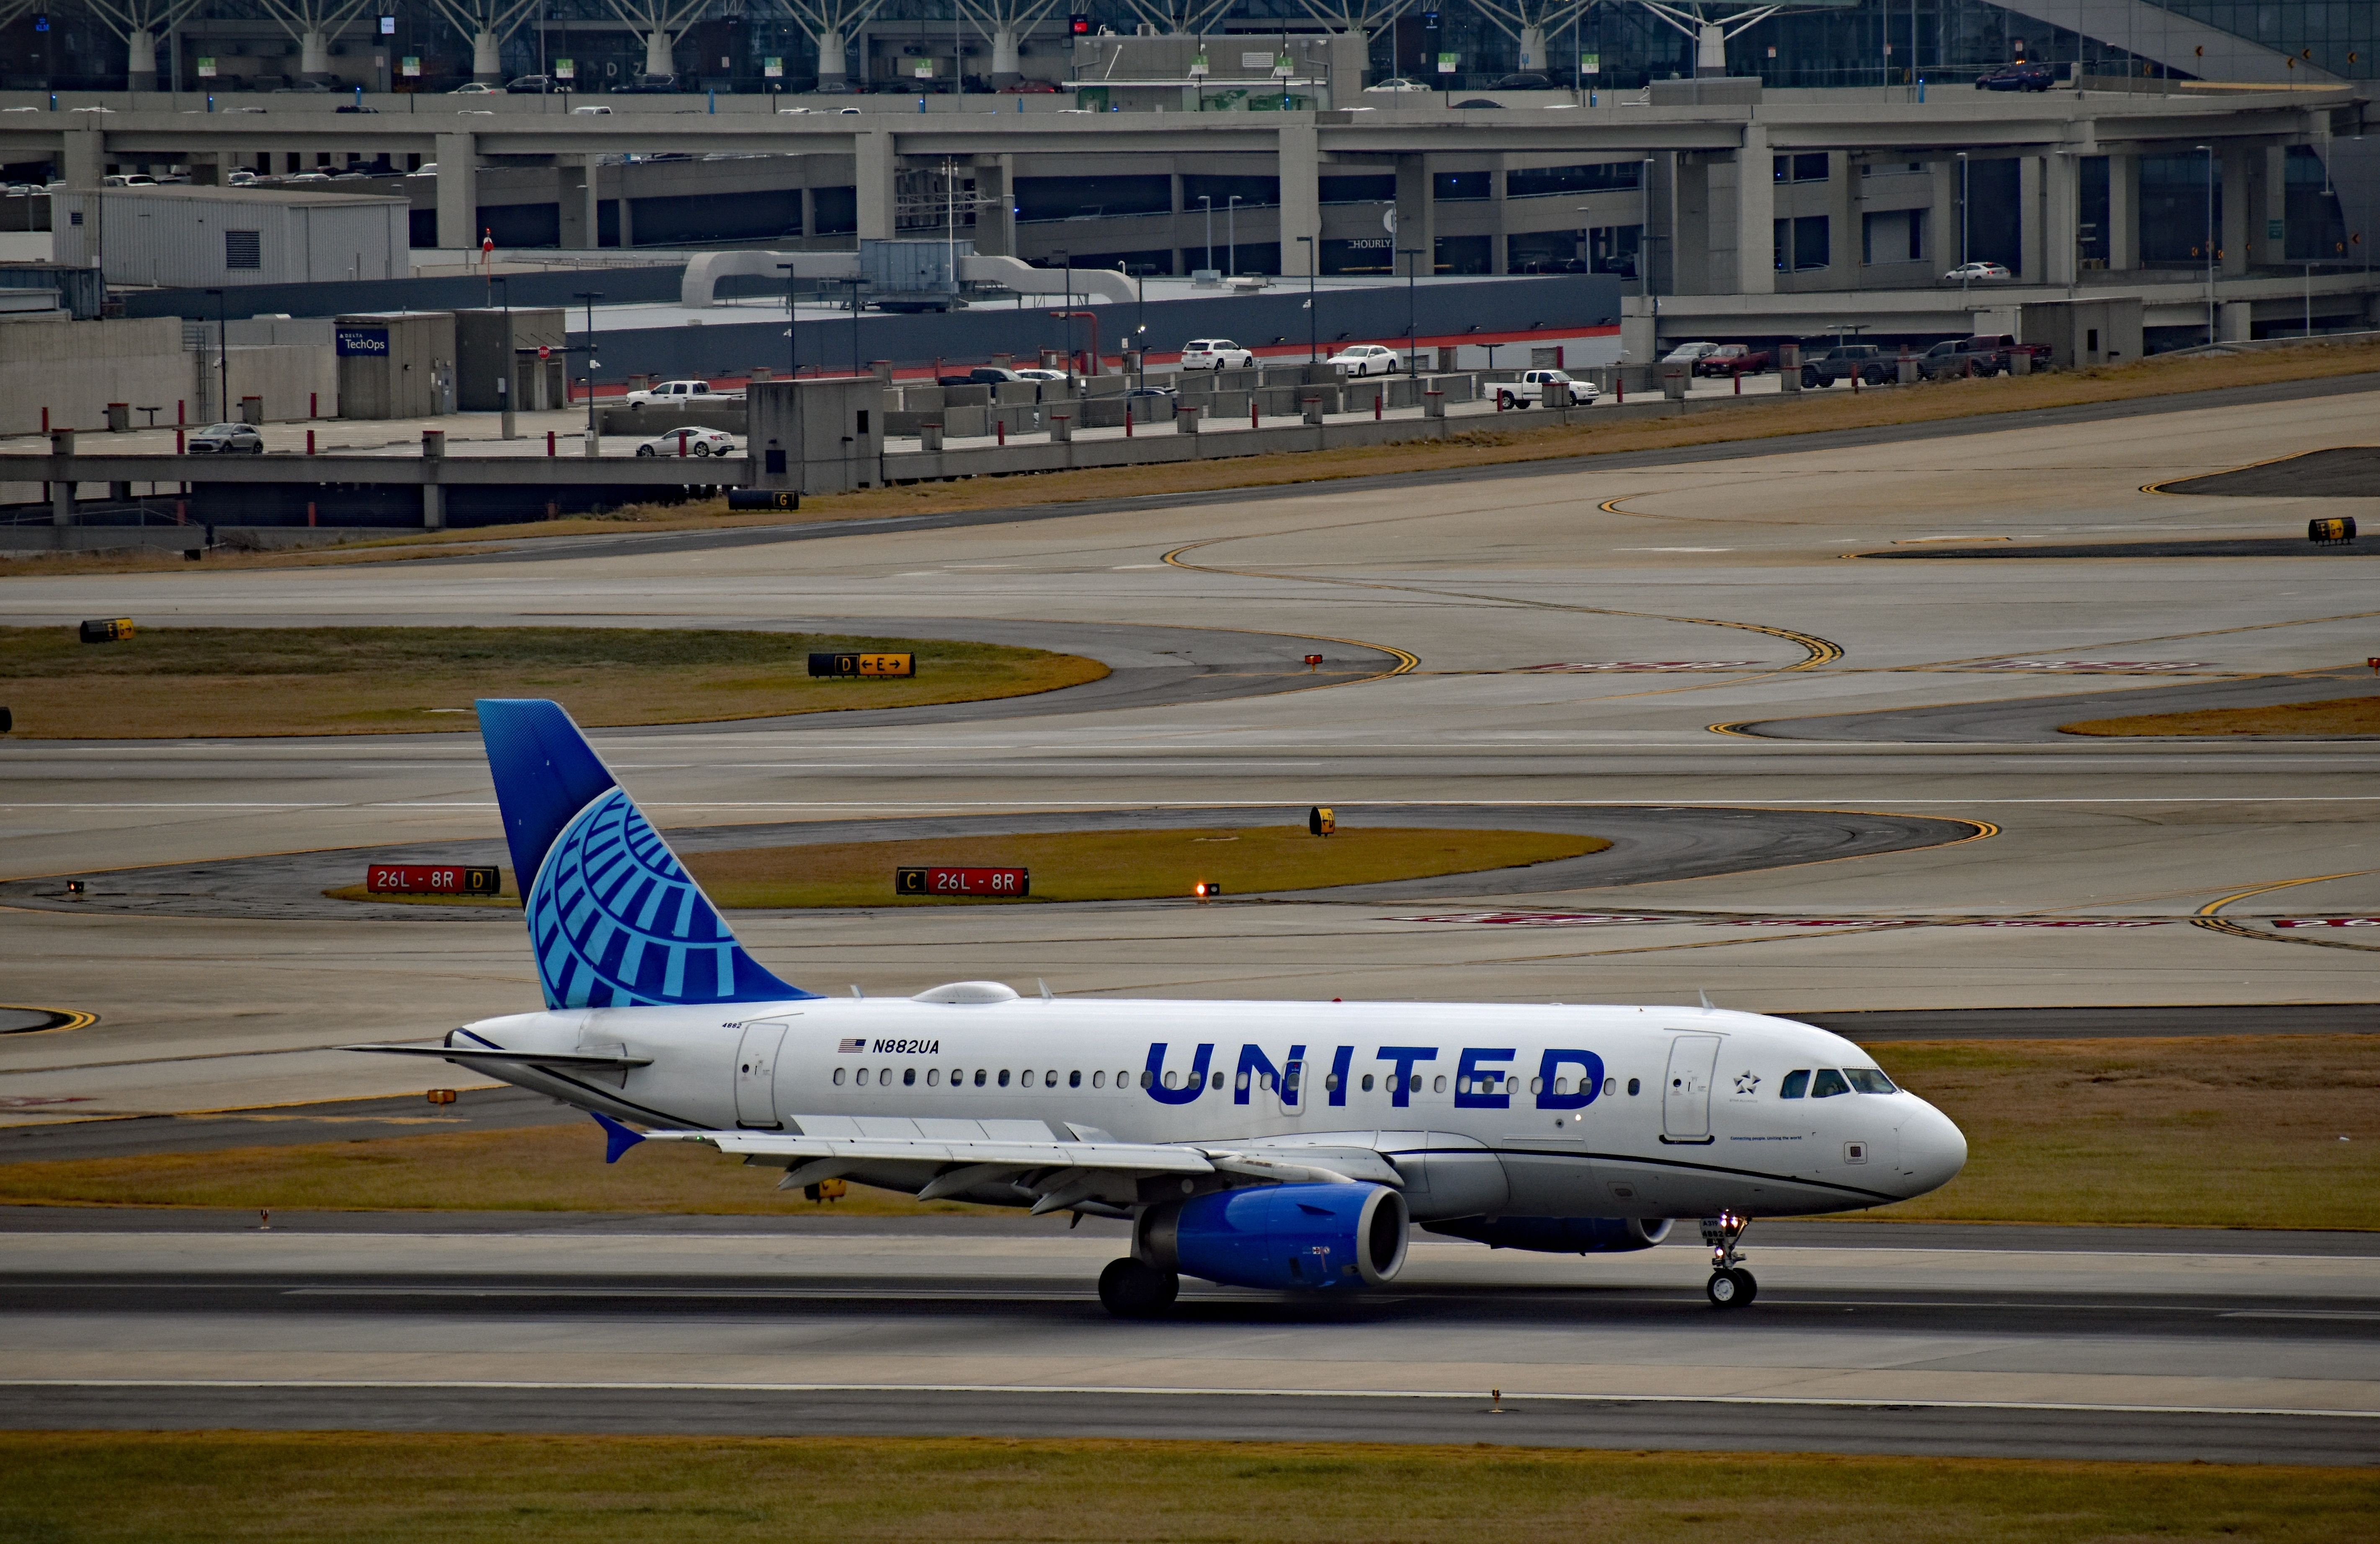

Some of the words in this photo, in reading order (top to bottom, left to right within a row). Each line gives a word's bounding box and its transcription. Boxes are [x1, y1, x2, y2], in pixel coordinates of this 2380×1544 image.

[606, 62, 617, 76] D
[1354, 240, 1391, 248] HOURLY
[345, 339, 385, 351] TechOps
[780, 494, 787, 506] G
[2320, 523, 2326, 536] E
[108, 624, 113, 637] E
[119, 623, 125, 636] G
[842, 658, 851, 671] D
[877, 658, 885, 671] E
[1328, 813, 1334, 828] D
[377, 871, 410, 887] 26L
[431, 871, 453, 887] 8R
[473, 872, 483, 888] D
[907, 873, 917, 889] C
[938, 873, 970, 889] 26L
[992, 873, 1014, 890] 8R
[874, 1039, 939, 1054] N882UA
[1146, 1043, 1604, 1110] UNITED
